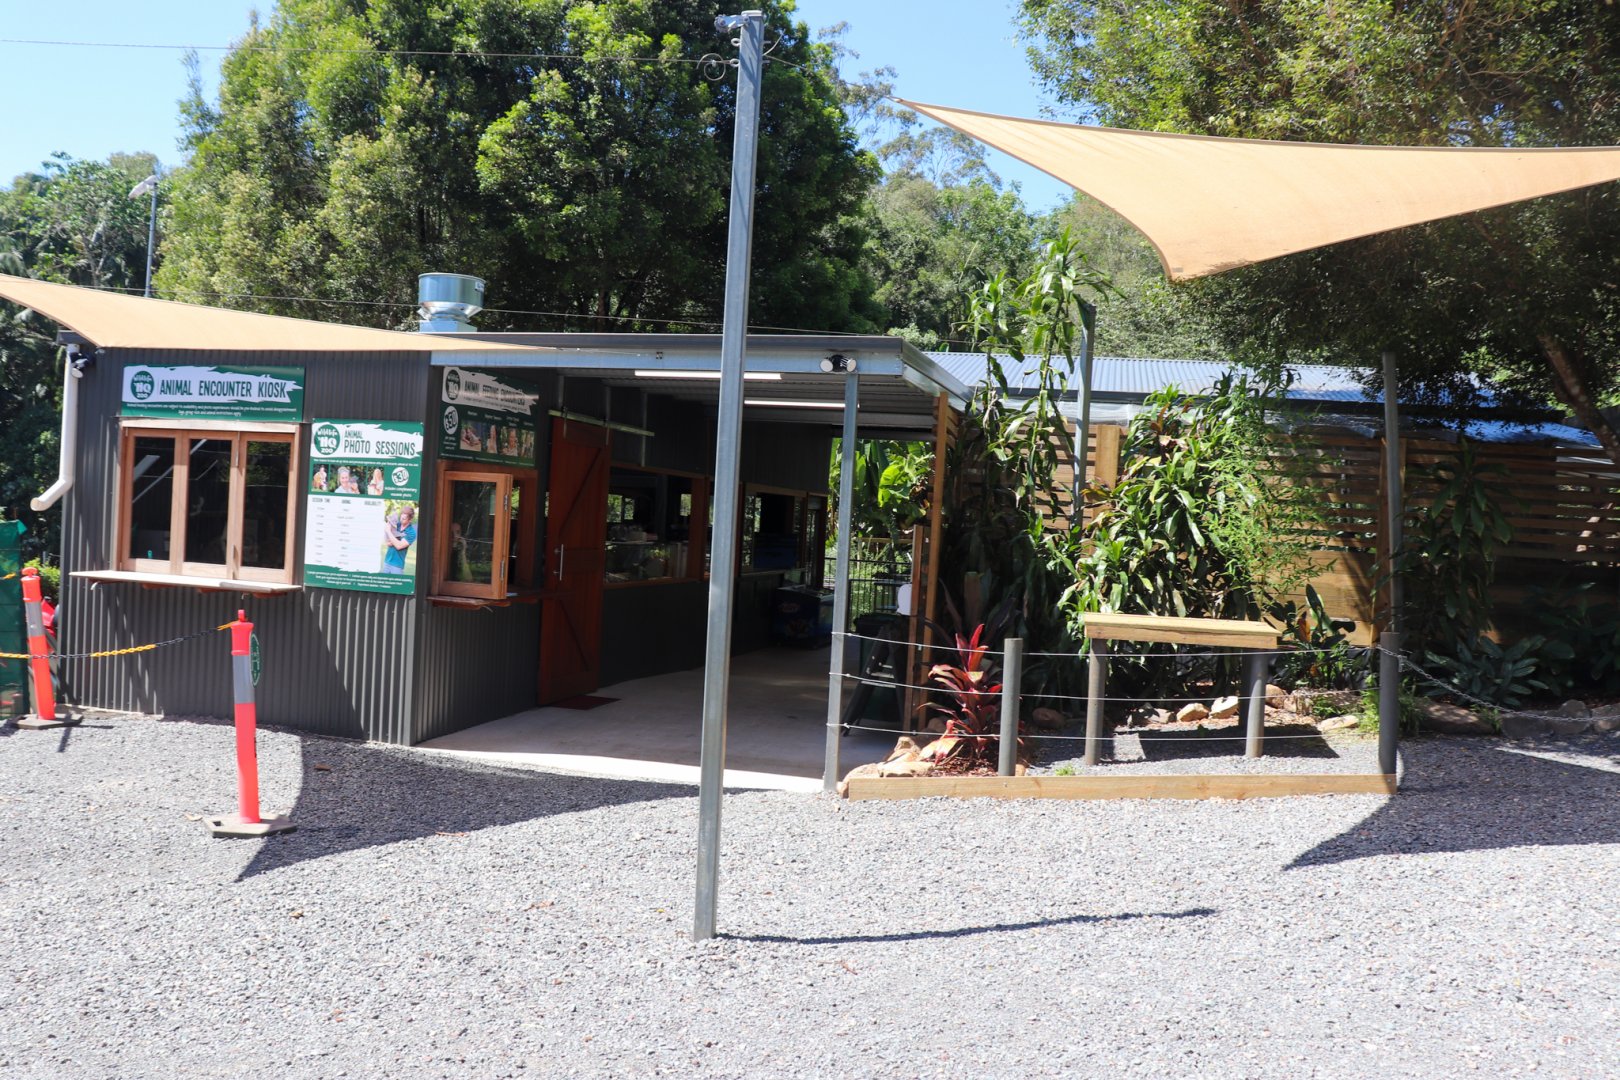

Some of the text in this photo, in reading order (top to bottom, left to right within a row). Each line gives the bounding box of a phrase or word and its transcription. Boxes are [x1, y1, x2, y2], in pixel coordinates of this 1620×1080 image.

[159, 379, 288, 399] ANIMAL ENCOUNTER KIOSK
[344, 430, 362, 439] ANIMAL
[317, 437, 337, 448] HQ
[344, 440, 416, 456] PHOTO SESSIONS
